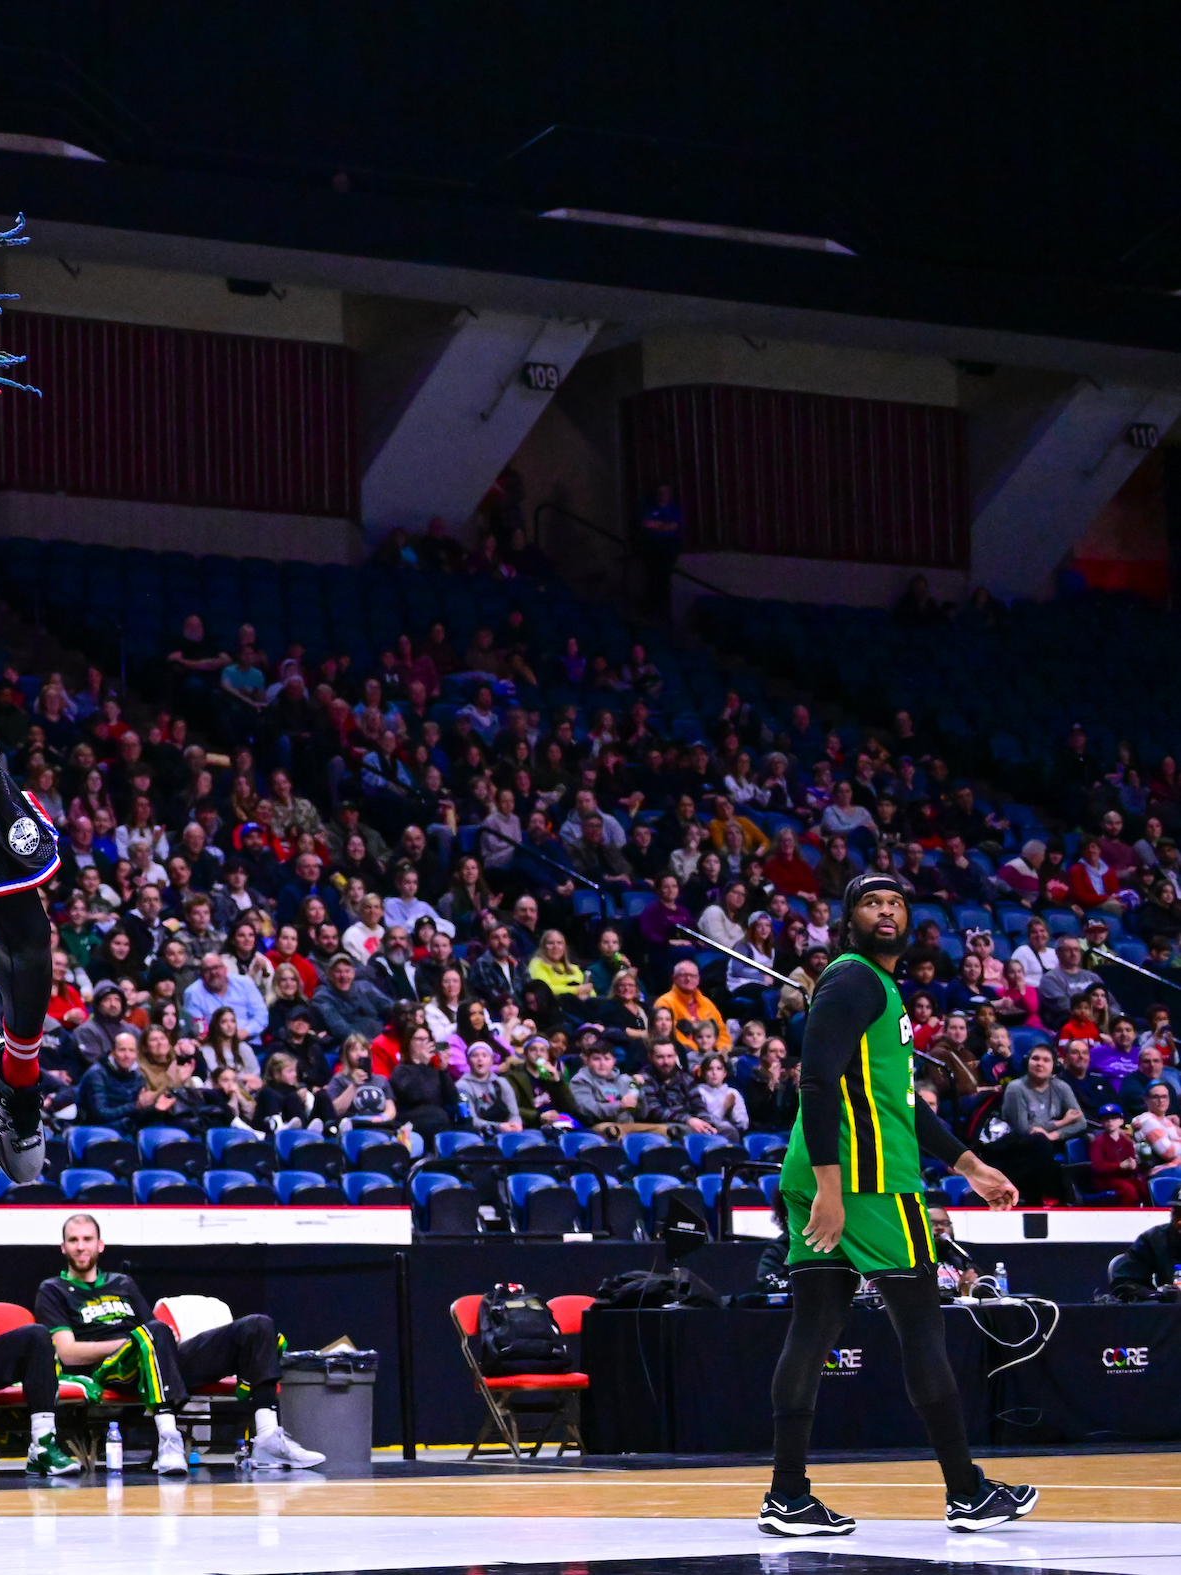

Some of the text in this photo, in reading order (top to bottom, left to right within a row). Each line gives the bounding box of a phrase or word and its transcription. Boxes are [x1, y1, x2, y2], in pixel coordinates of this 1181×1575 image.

[527, 365, 559, 390] 109
[1131, 426, 1158, 448] 110
[823, 1348, 863, 1369] ORE
[1102, 1347, 1149, 1367] CORE
